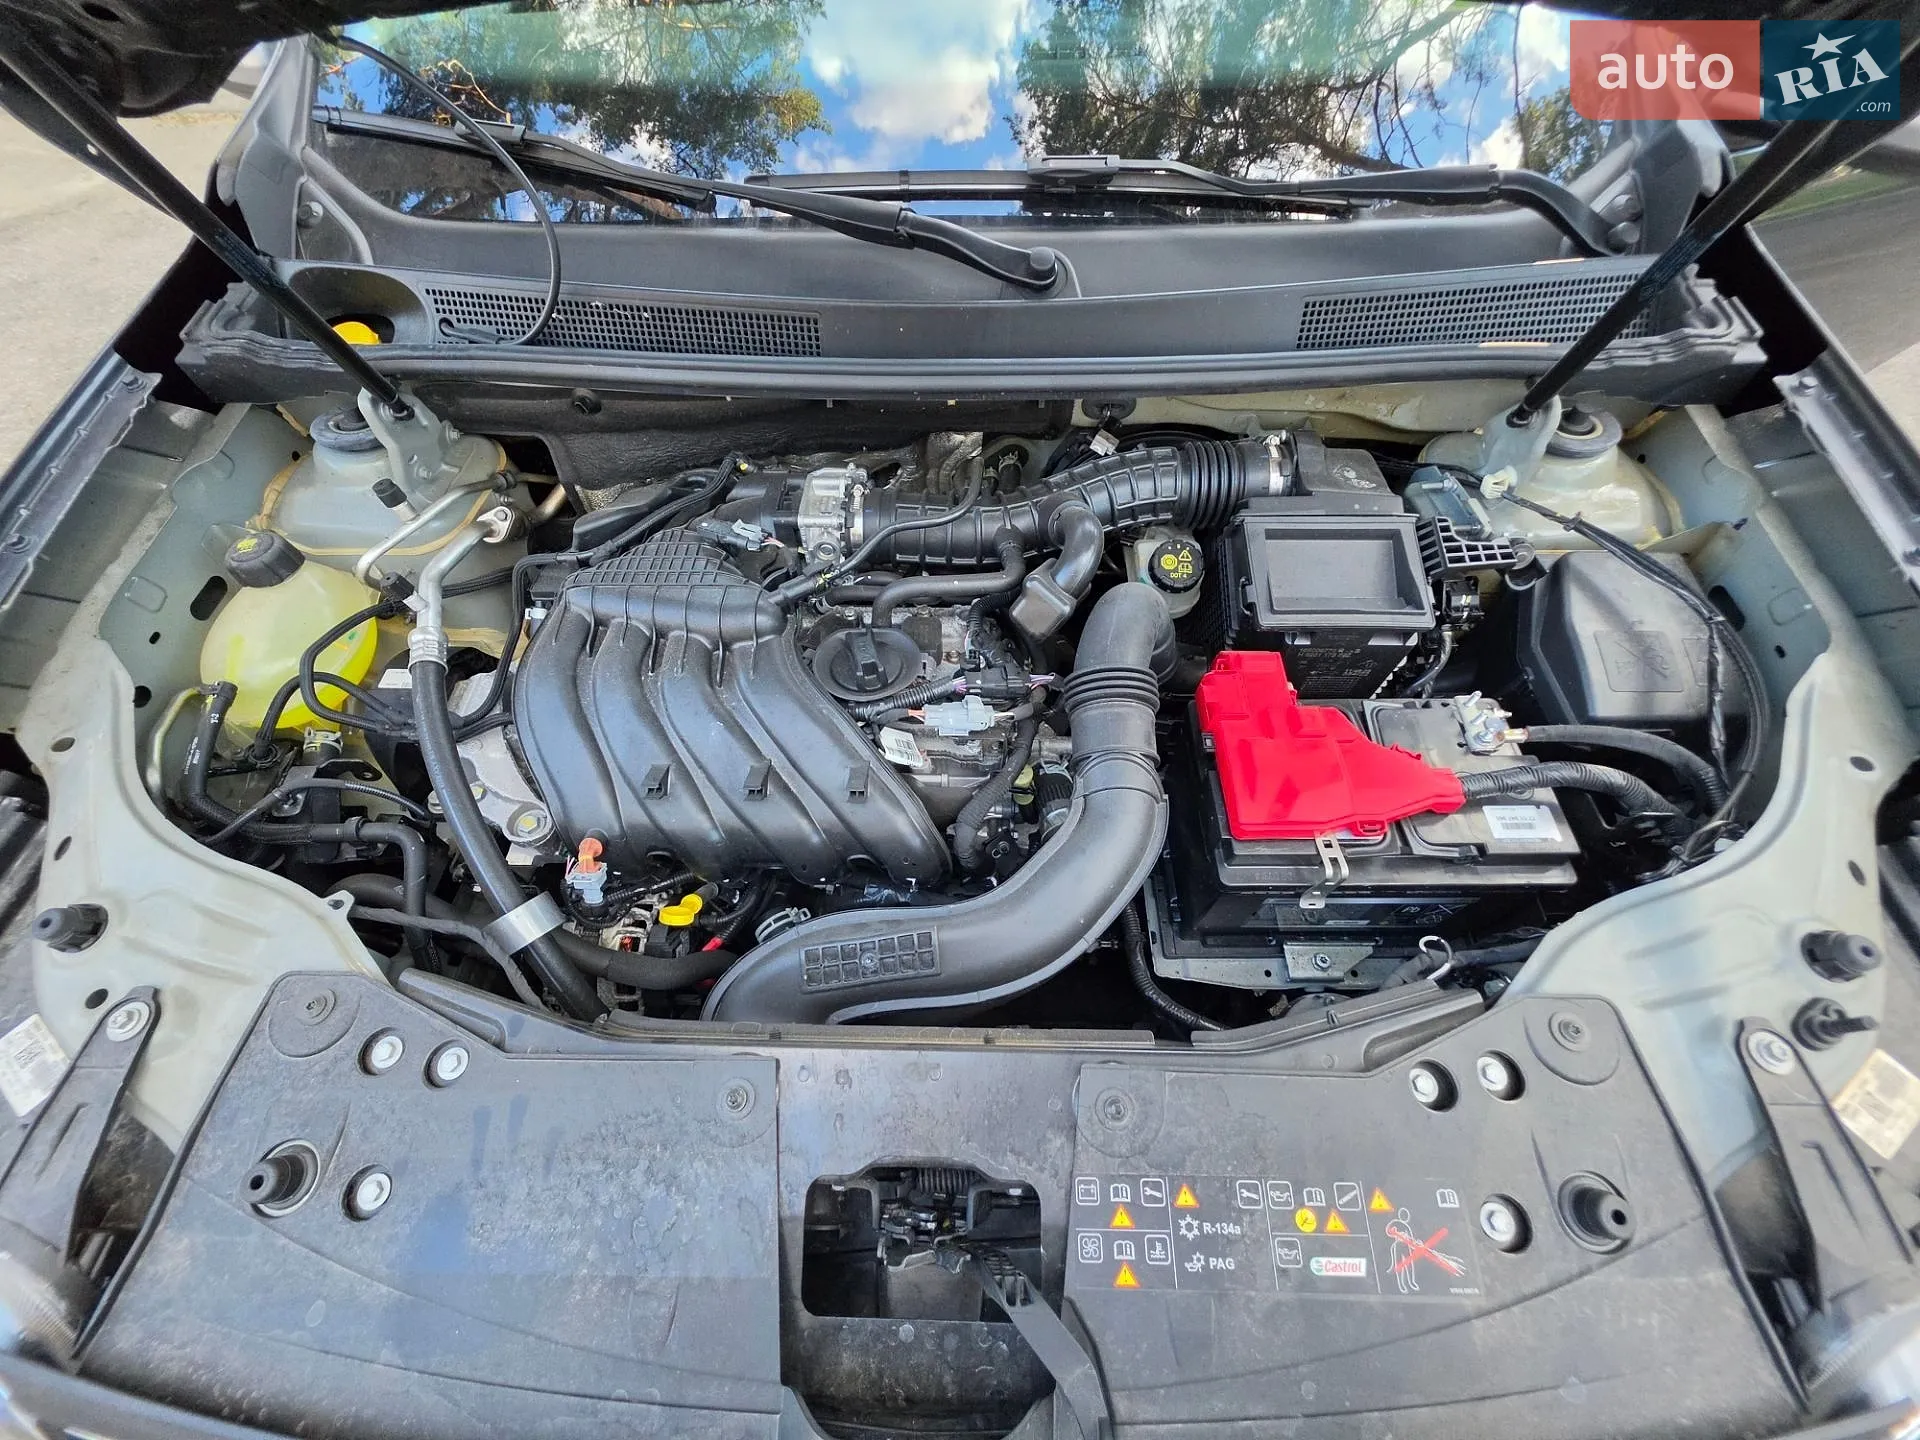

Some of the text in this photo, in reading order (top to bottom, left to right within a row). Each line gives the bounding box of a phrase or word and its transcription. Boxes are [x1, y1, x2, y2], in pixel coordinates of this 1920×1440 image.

[1203, 1223, 1241, 1236] R-134a
[1208, 1257, 1236, 1270] PAG
[1324, 1259, 1363, 1273] Castrol
